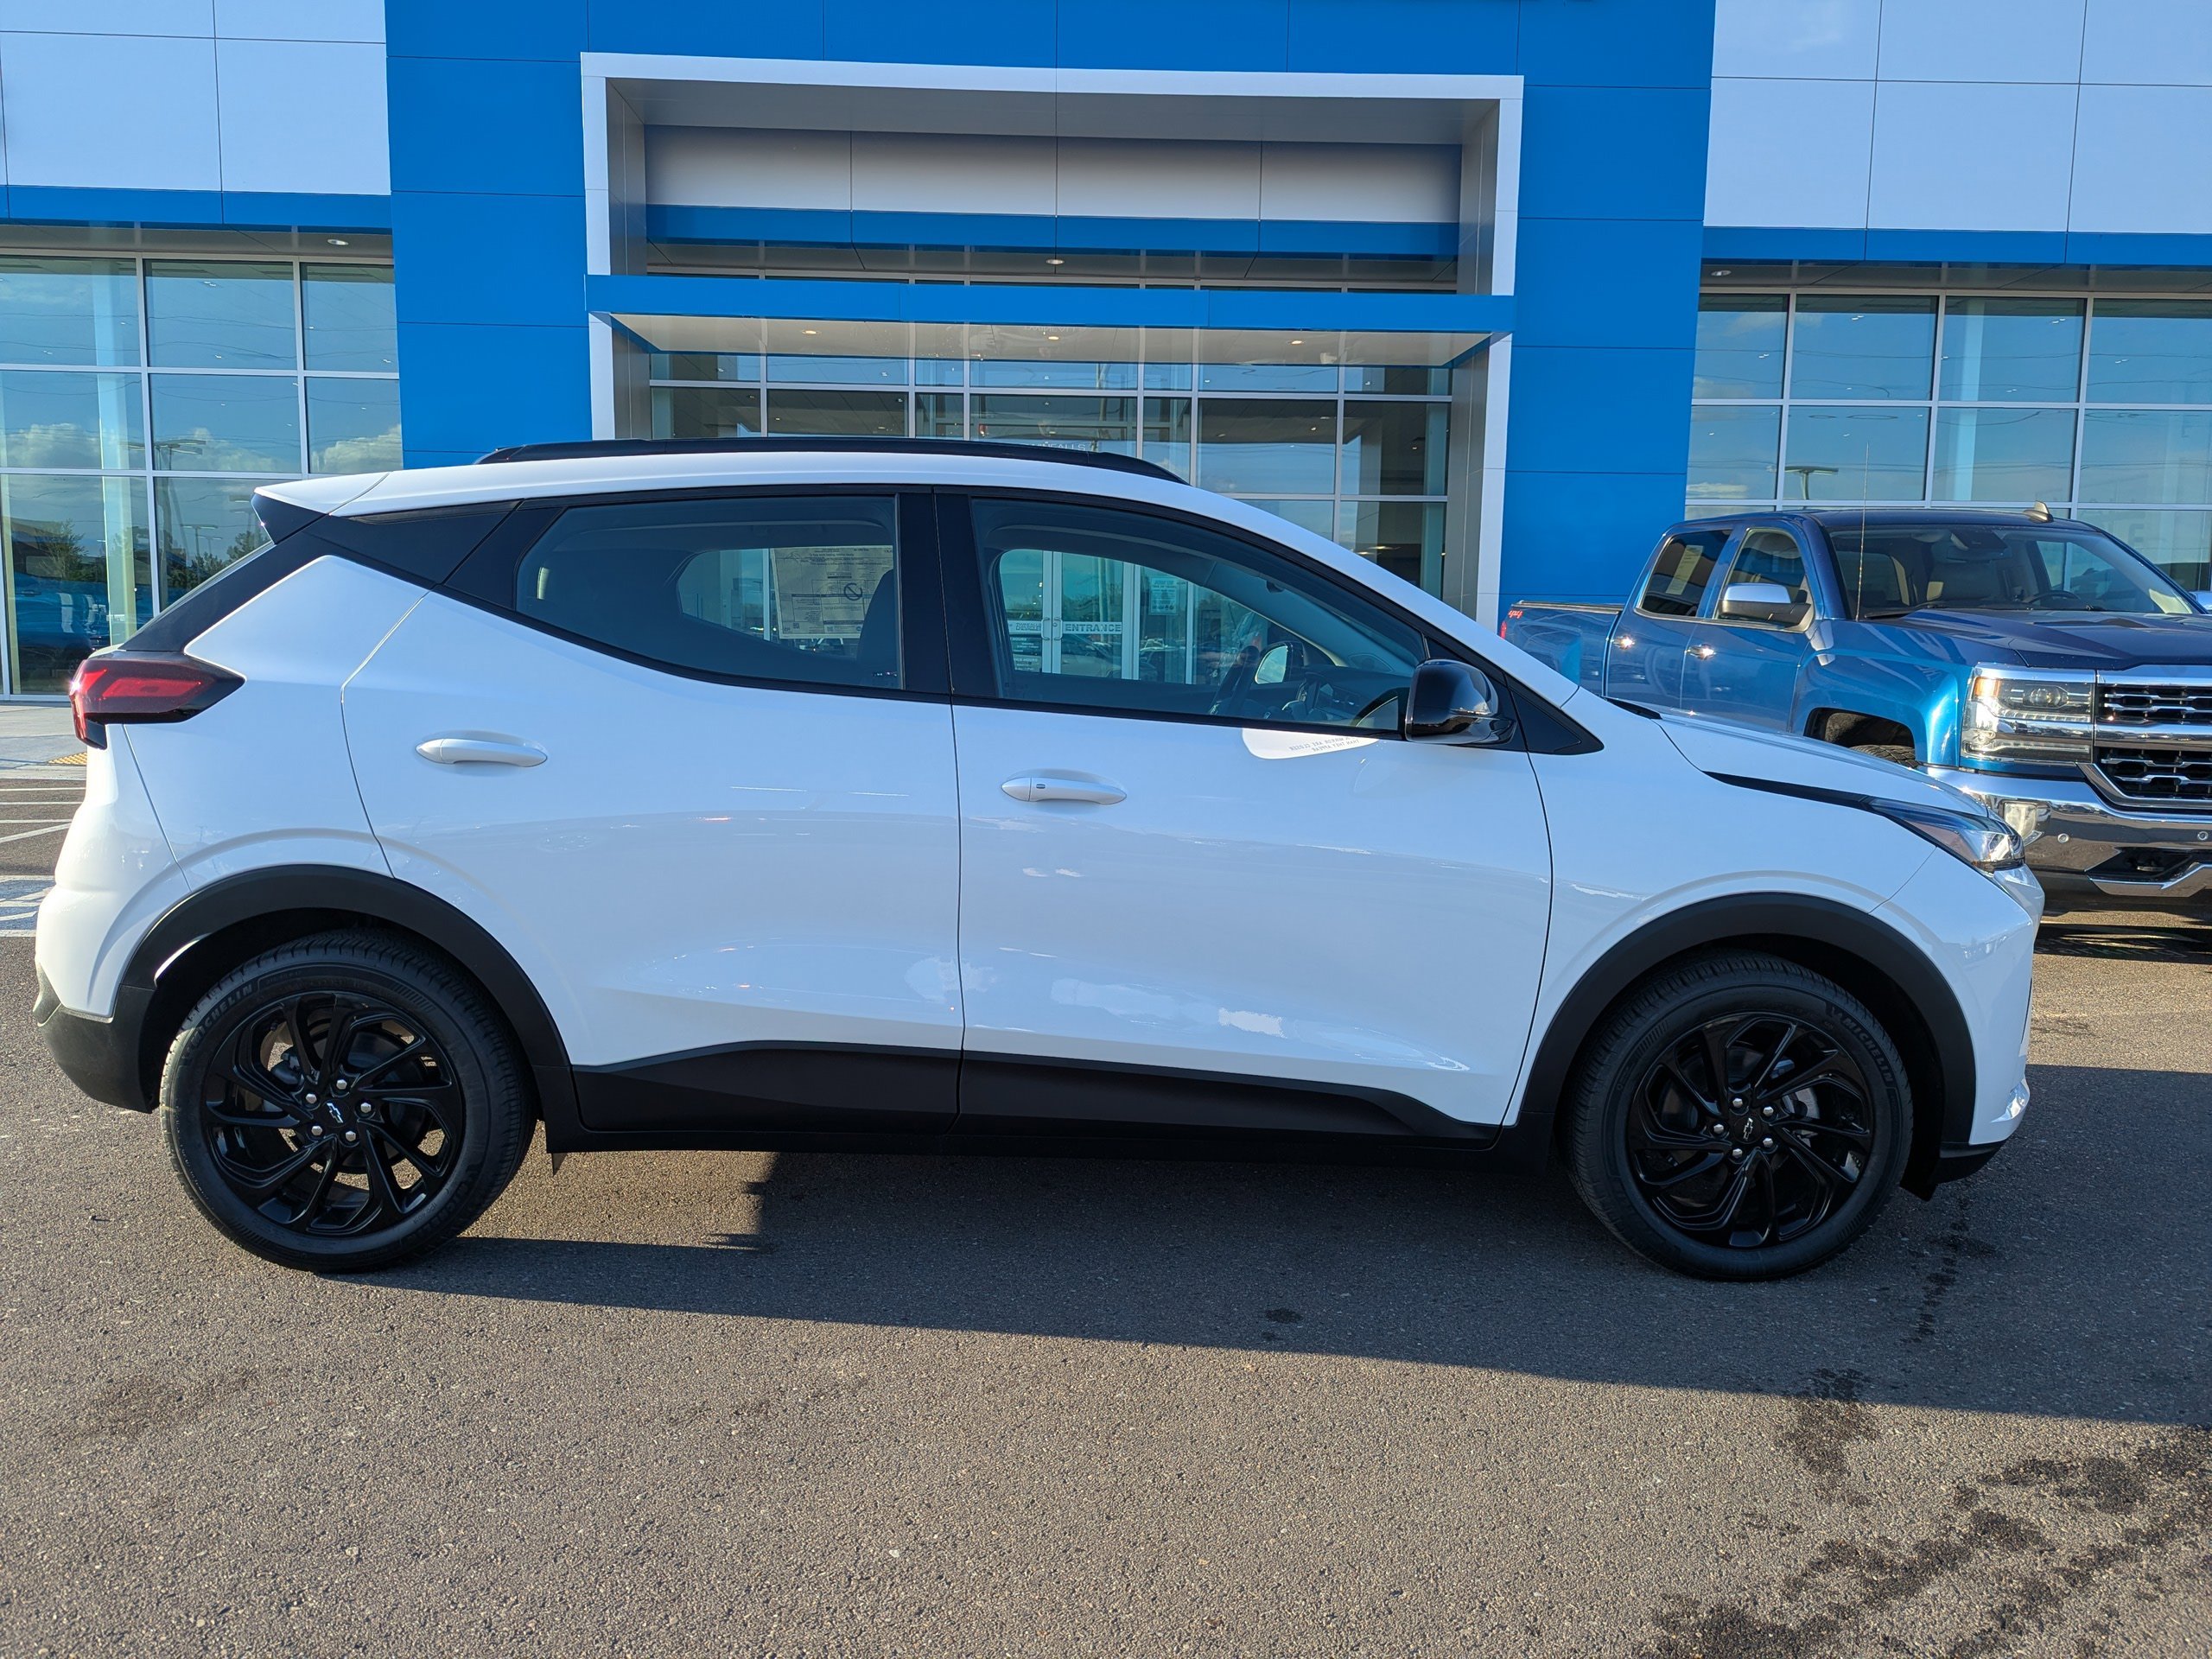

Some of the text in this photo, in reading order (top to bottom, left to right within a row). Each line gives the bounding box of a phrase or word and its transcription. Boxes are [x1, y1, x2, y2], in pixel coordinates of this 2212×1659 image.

[1065, 624, 1122, 632] ENTRANCE
[189, 983, 253, 1044] MICHELIN
[1842, 1017, 1894, 1083] MICHELIN
